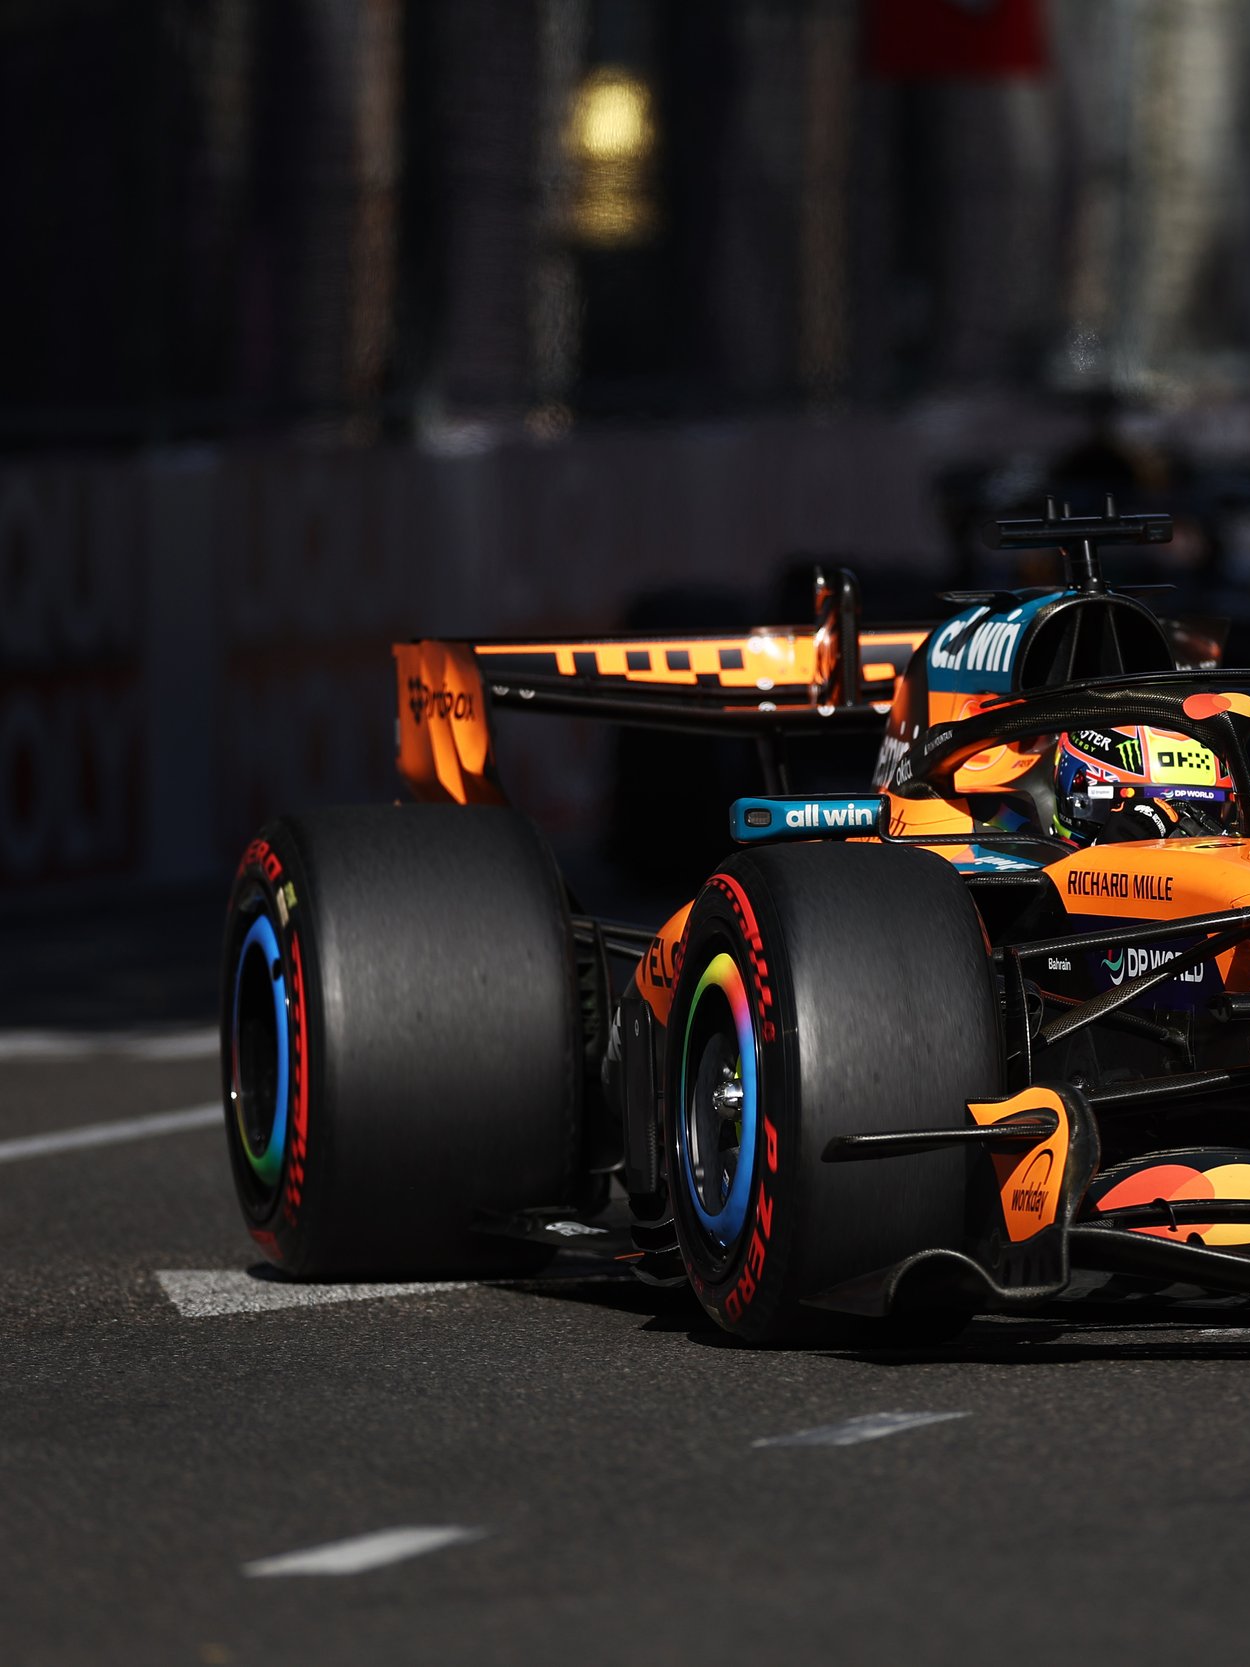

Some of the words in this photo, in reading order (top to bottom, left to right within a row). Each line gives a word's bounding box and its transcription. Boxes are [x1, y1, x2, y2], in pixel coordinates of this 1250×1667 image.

[966, 608, 1022, 672] win
[1174, 789, 1188, 798] DP
[1187, 790, 1215, 799] WORLD
[785, 804, 819, 828] all
[822, 803, 873, 826] win
[1067, 870, 1129, 898] RICHARD
[1133, 874, 1174, 901] MILLE
[1048, 957, 1072, 971] Bahrain
[1127, 947, 1149, 977] DP
[763, 1112, 778, 1174] P
[1011, 1181, 1049, 1221] workday
[724, 1180, 774, 1323] ZERO
